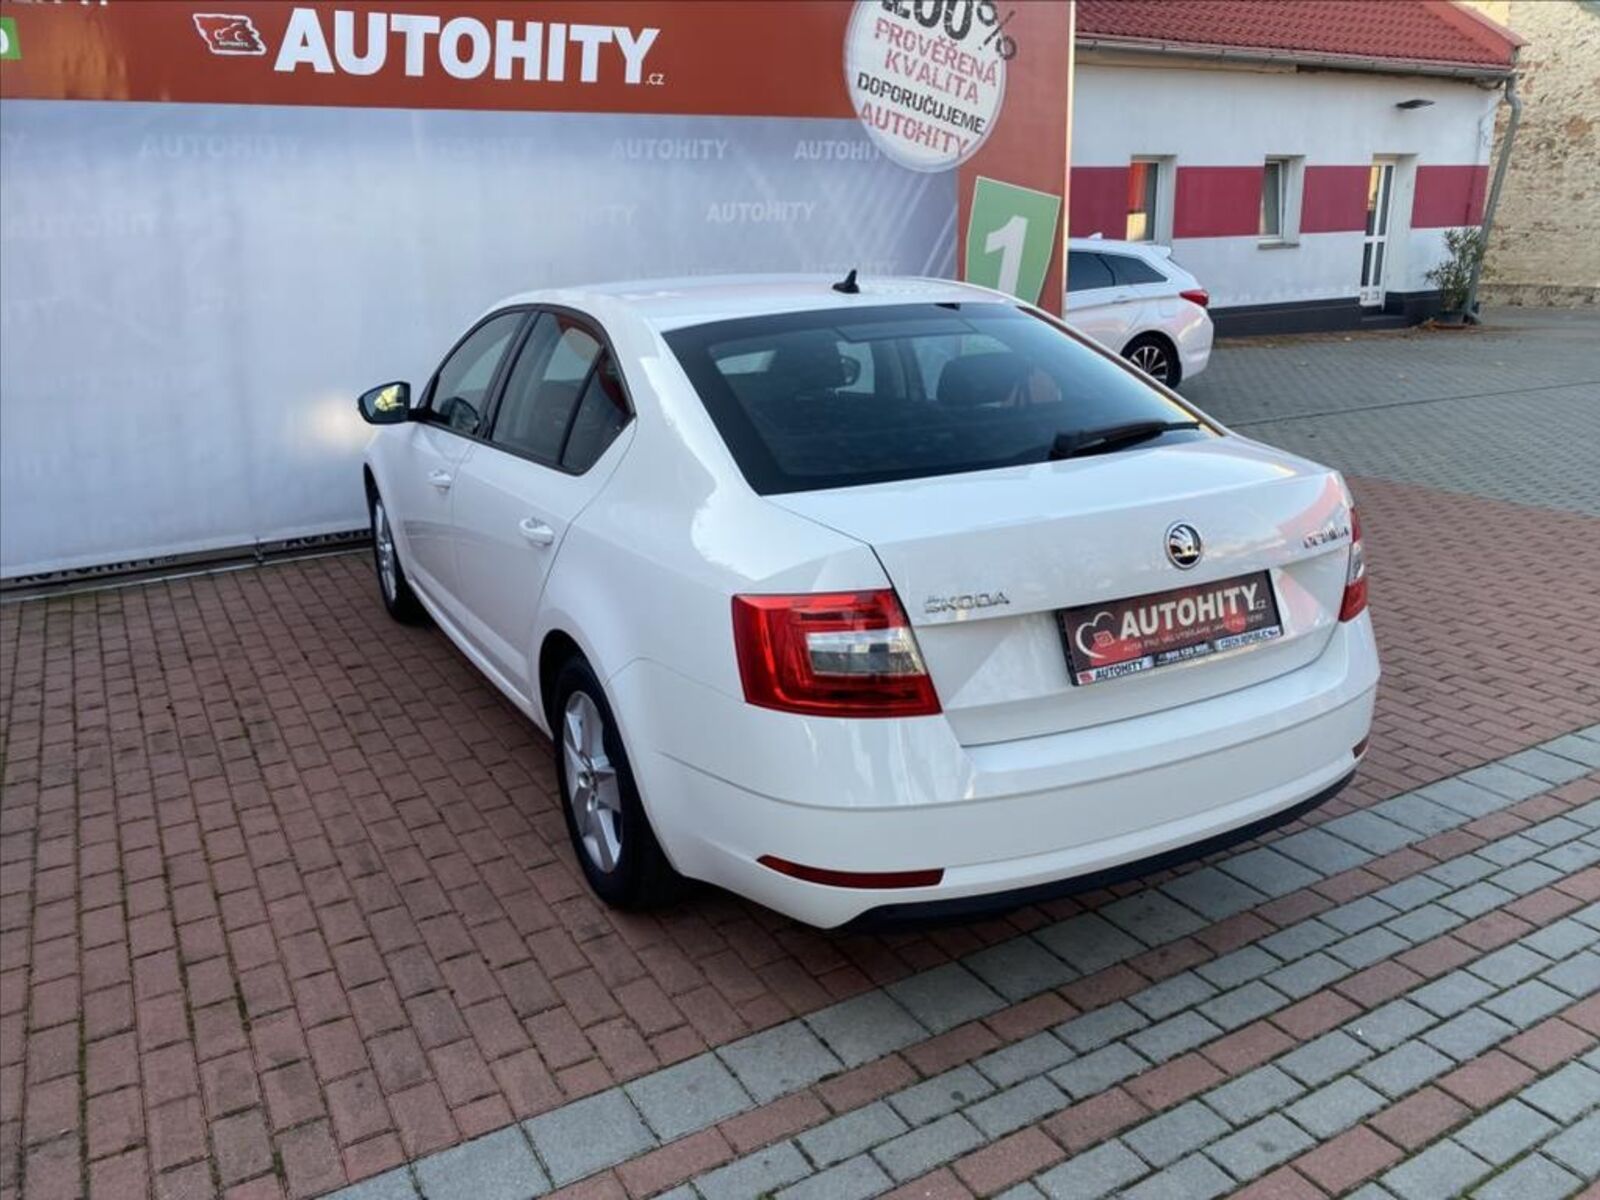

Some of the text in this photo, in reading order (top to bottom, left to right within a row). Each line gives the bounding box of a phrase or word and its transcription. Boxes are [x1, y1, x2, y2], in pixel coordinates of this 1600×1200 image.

[273, 7, 660, 84] AUTOHITY
[874, 17, 998, 87] PROVĚŘENÁ
[856, 71, 986, 136] DOPORUČUJEME
[884, 49, 979, 105] KVALITA
[611, 137, 729, 161] AUTOHITY
[859, 101, 970, 158] AUTOHITY
[706, 200, 817, 224] AUTOHITY
[984, 214, 1029, 297] 1
[1118, 583, 1258, 641] AUTOHITY
